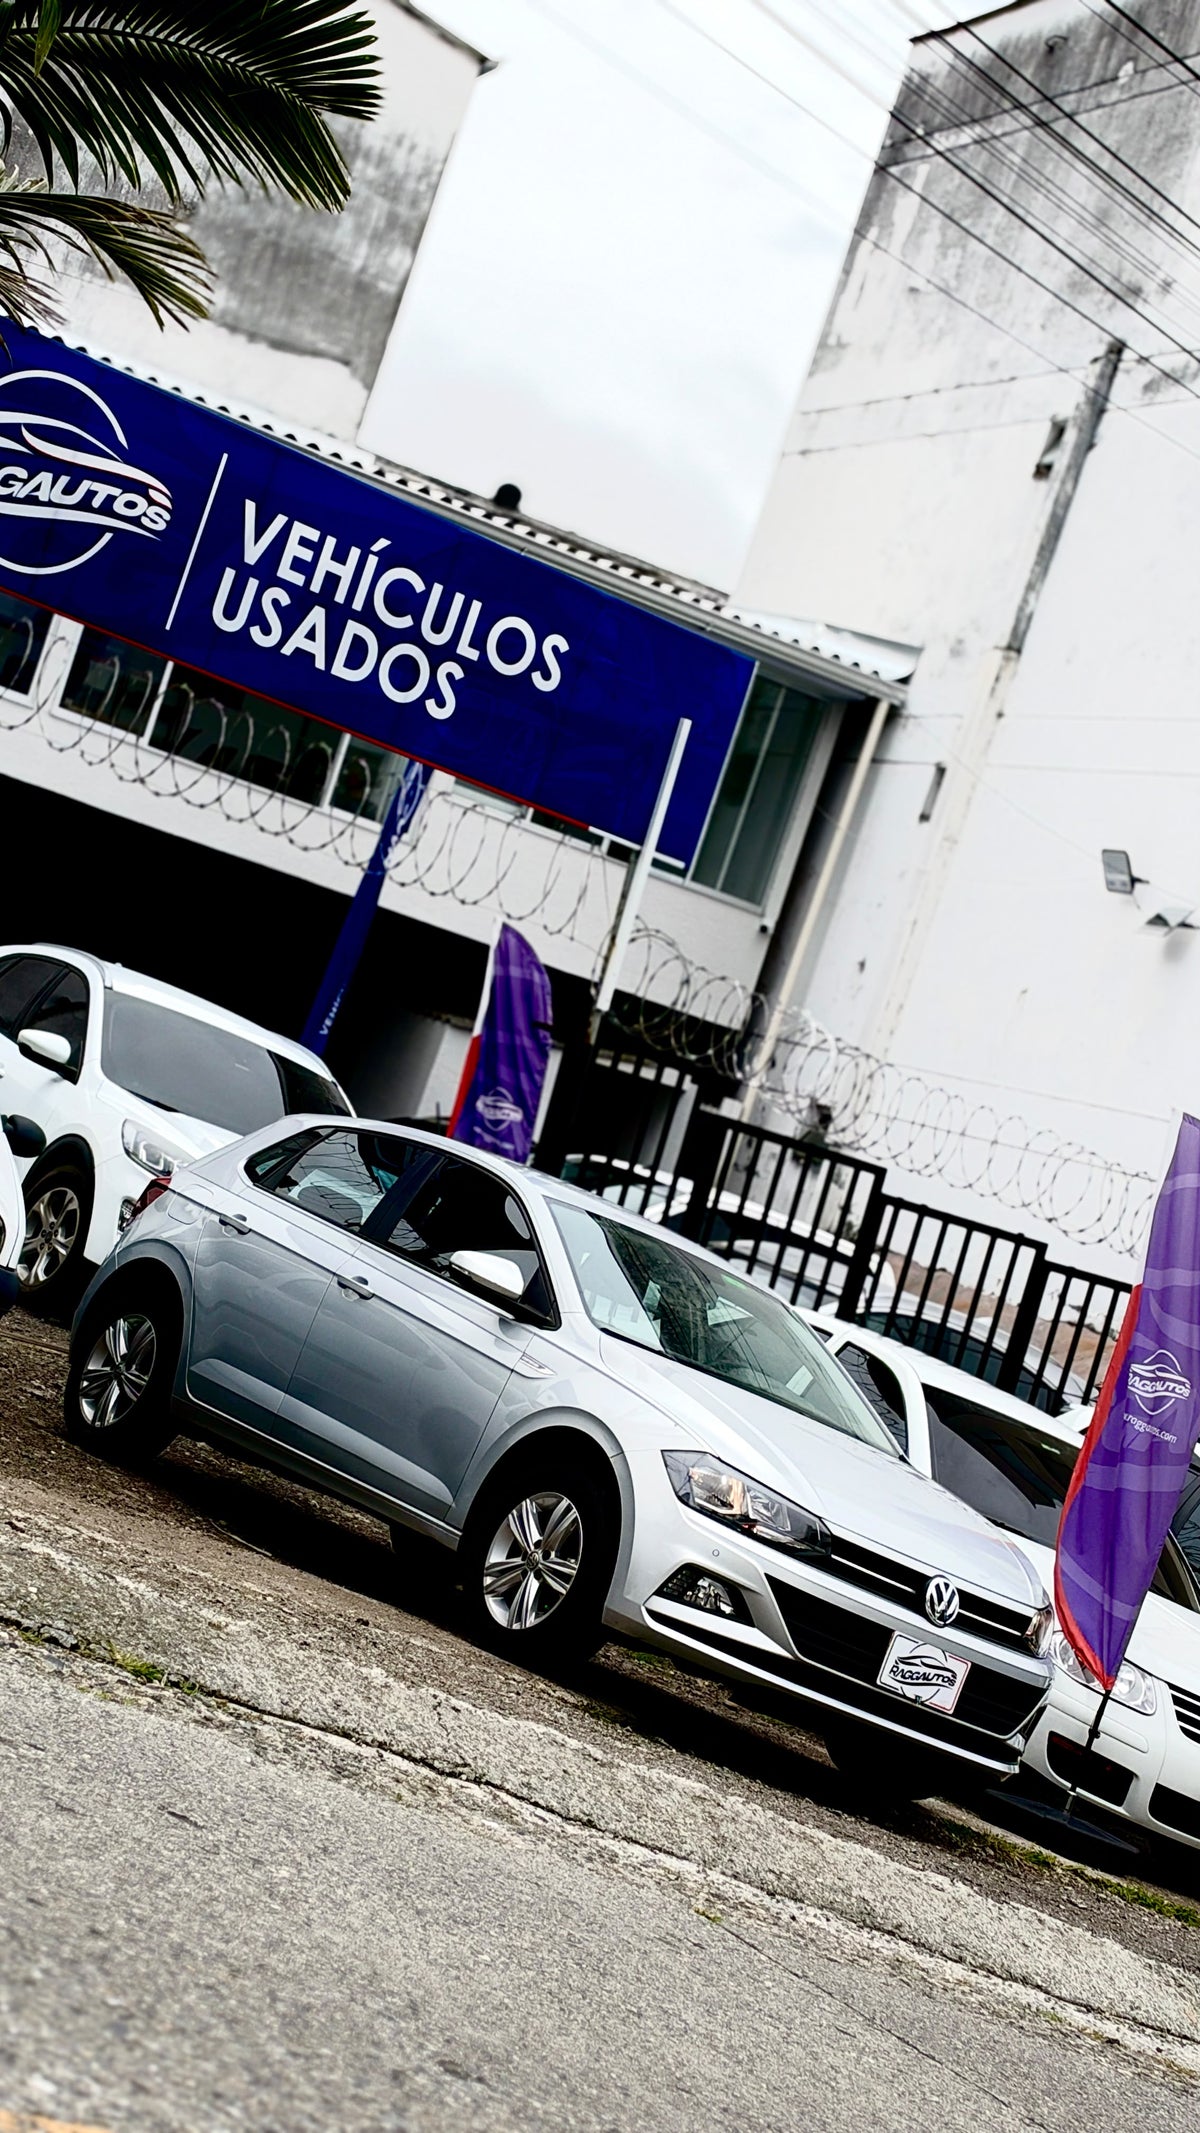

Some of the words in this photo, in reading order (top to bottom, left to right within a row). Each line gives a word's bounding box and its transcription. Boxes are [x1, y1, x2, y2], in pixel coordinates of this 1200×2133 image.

[212, 566, 466, 720] USADOS
[243, 498, 570, 692] VEHÍCULOS
[889, 1665, 957, 1686] RAGGAUTOS
